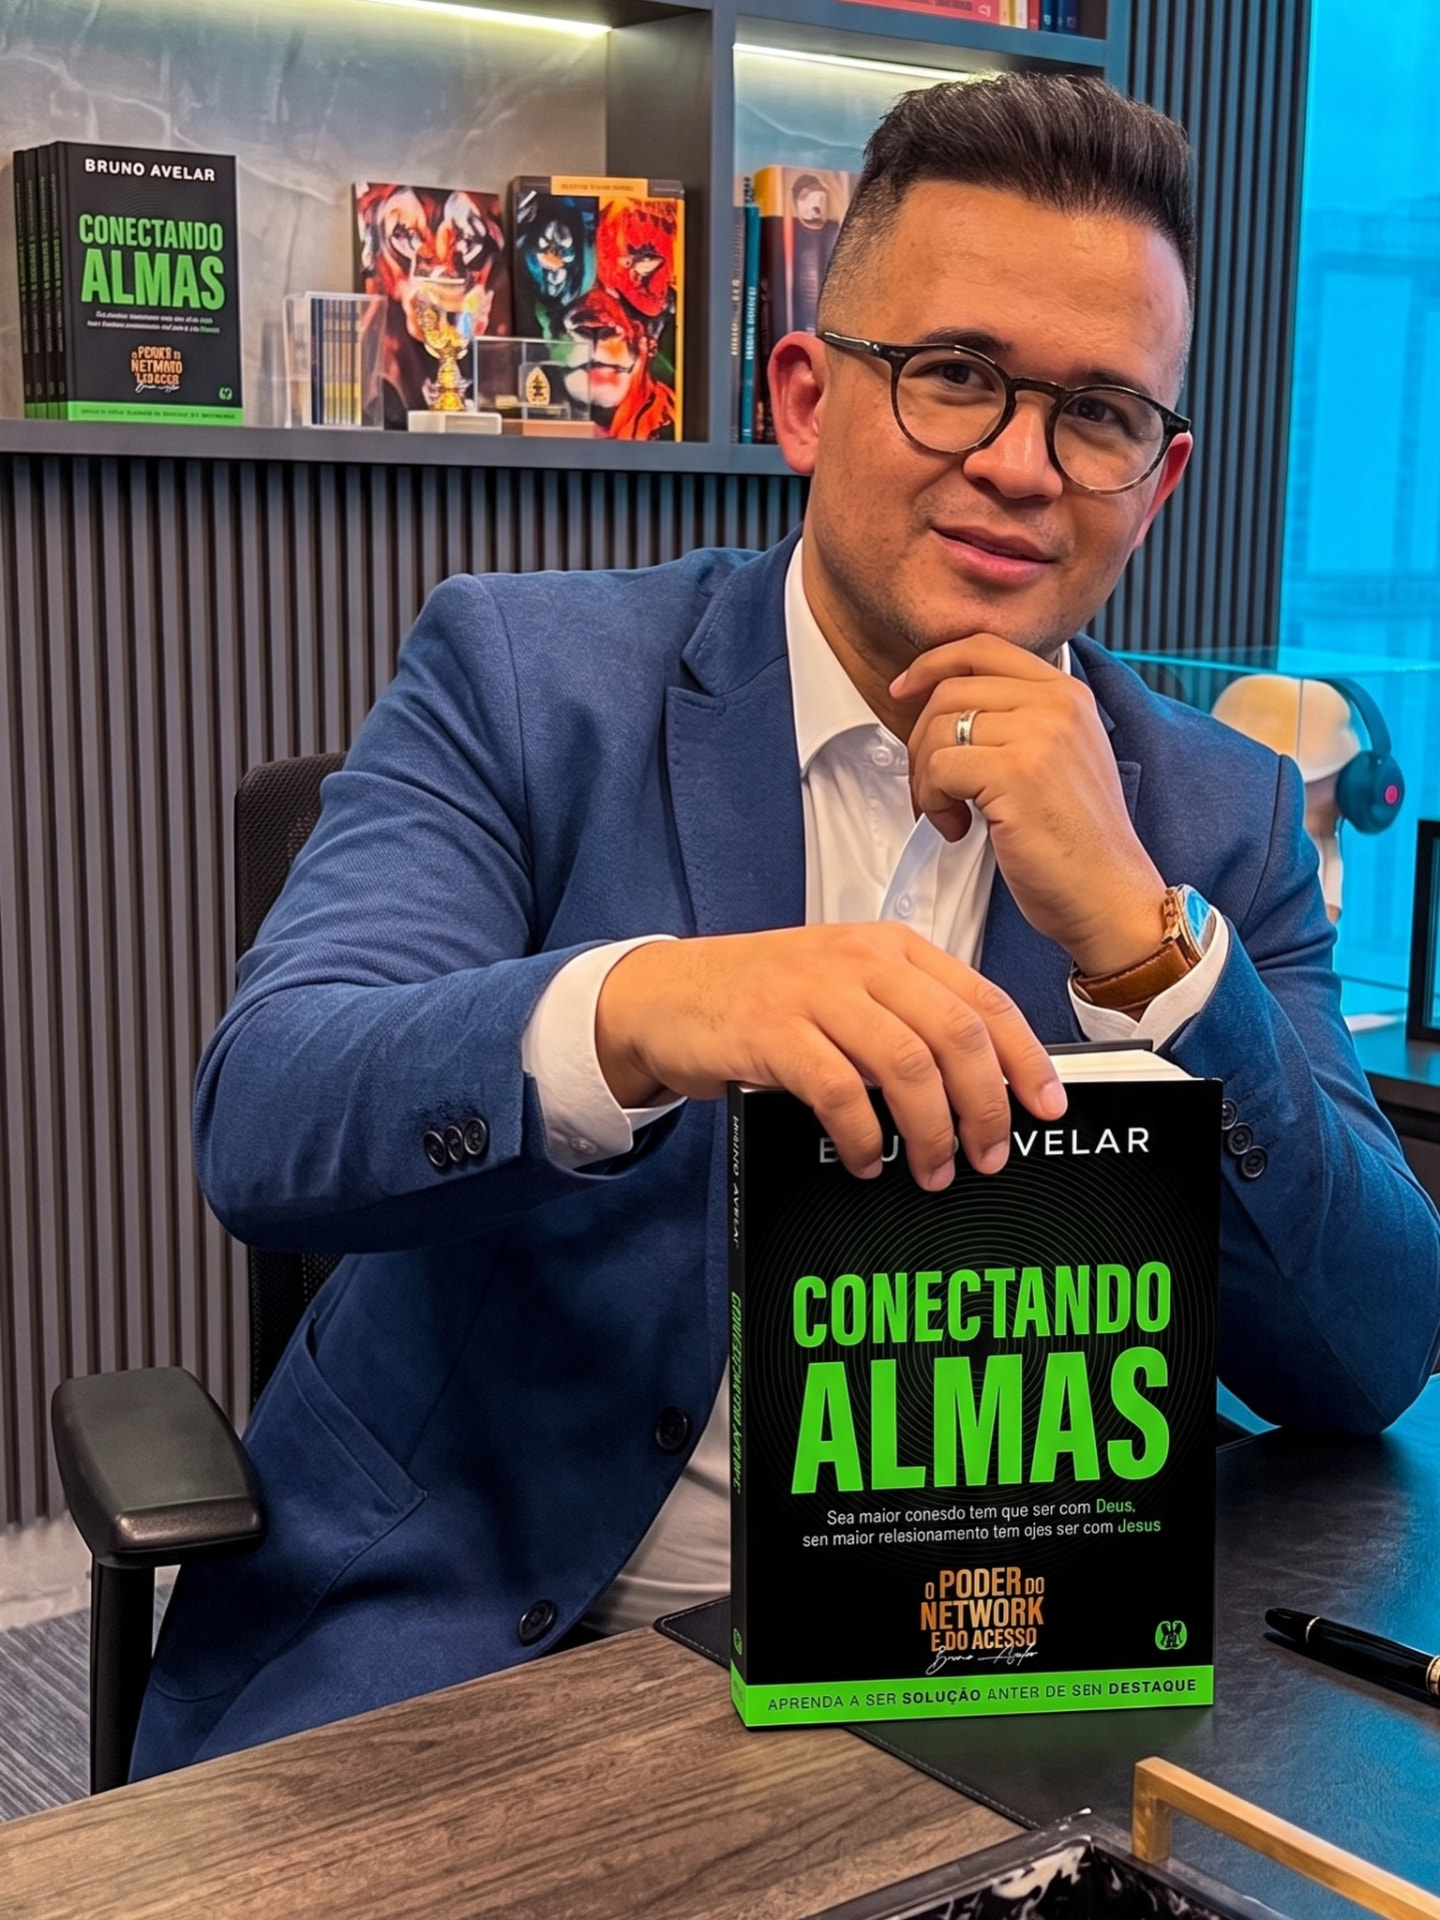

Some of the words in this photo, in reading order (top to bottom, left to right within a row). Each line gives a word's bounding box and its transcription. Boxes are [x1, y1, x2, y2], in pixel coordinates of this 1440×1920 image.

[84, 158, 145, 177] BRUNO
[150, 164, 216, 182] AVELAR
[78, 213, 224, 252] CONECTANDO
[80, 247, 226, 310] ALMAS
[1013, 1126, 1150, 1157] VELAR
[792, 1261, 1171, 1348] CONECTANDO
[791, 1346, 1170, 1495] ALMAS
[827, 1510, 854, 1526] Sea
[859, 1507, 902, 1524] maior
[905, 1505, 966, 1522] conesdo
[969, 1505, 998, 1520] tem
[1001, 1505, 1029, 1522] que
[1033, 1503, 1056, 1517] ser
[1059, 1502, 1091, 1516] com
[802, 1535, 829, 1548] sen
[833, 1530, 876, 1546] maior
[878, 1526, 989, 1544] relesionamento
[993, 1524, 1020, 1539] tem
[1056, 1523, 1080, 1536] ser
[1083, 1521, 1114, 1535] com
[1117, 1518, 1162, 1533] Jesus
[925, 1582, 935, 1600] O
[939, 1566, 1022, 1599] PODER
[1025, 1576, 1045, 1595] DO
[920, 1596, 1045, 1631] NETWORK
[931, 1631, 942, 1652] E
[945, 1630, 969, 1651] DO
[971, 1627, 1037, 1650] ACESSO
[767, 1695, 844, 1711] APRENDA
[850, 1695, 860, 1707] A
[865, 1693, 896, 1706] SER
[902, 1687, 981, 1706] SOLUÇÃO
[987, 1685, 1039, 1700] ANTER
[1045, 1685, 1066, 1698] DE
[1108, 1678, 1196, 1695] DESTAQUE
